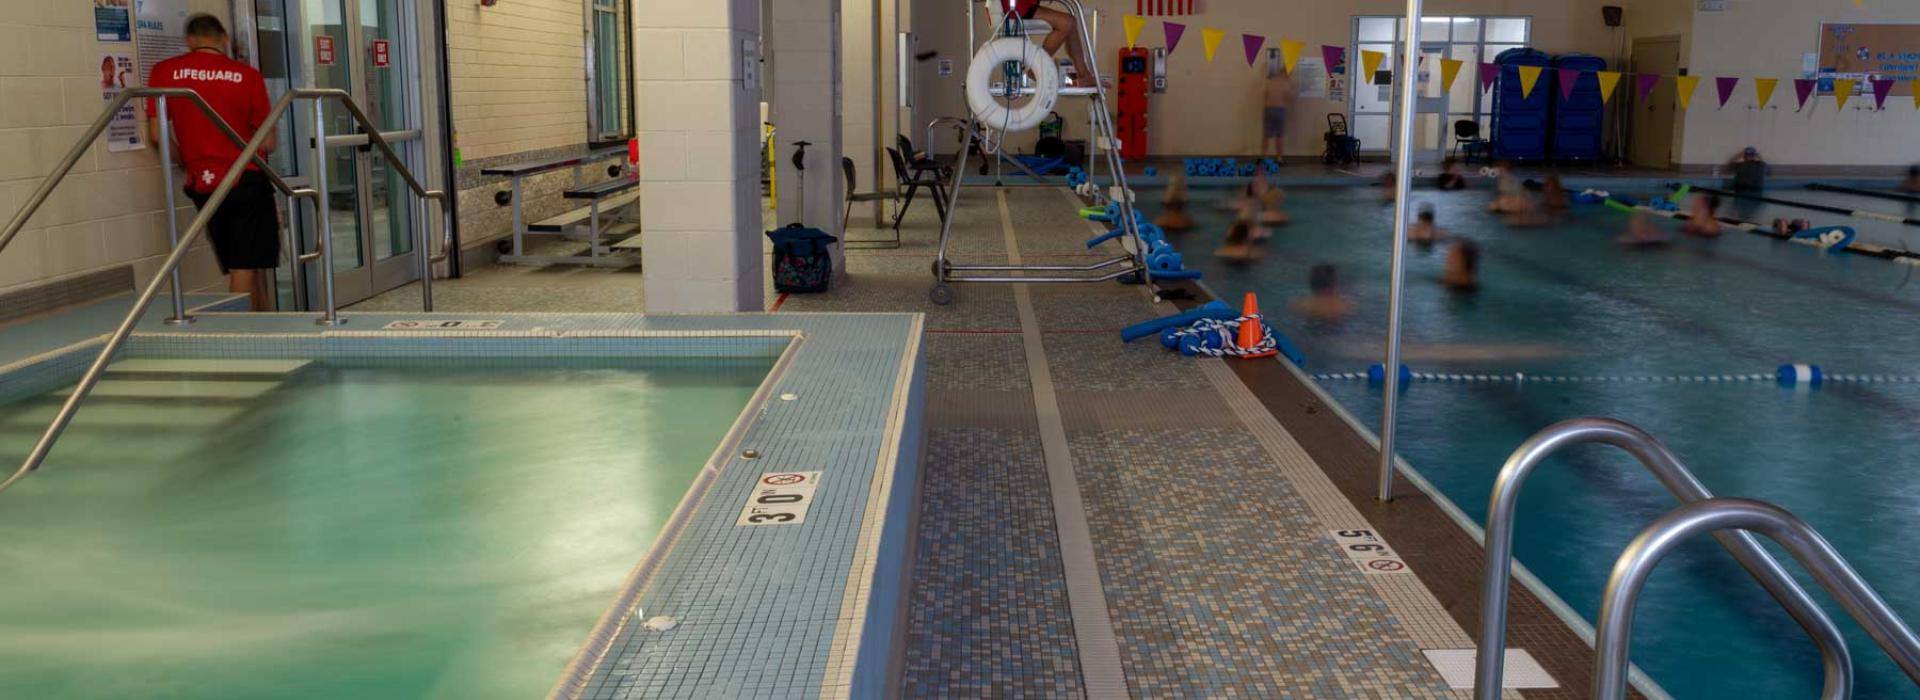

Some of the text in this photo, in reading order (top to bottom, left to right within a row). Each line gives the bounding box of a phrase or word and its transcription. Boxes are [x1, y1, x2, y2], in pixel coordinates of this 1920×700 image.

[173, 69, 243, 83] LIFEGUARD
[757, 494, 804, 504] 0
[748, 513, 796, 523] 3
